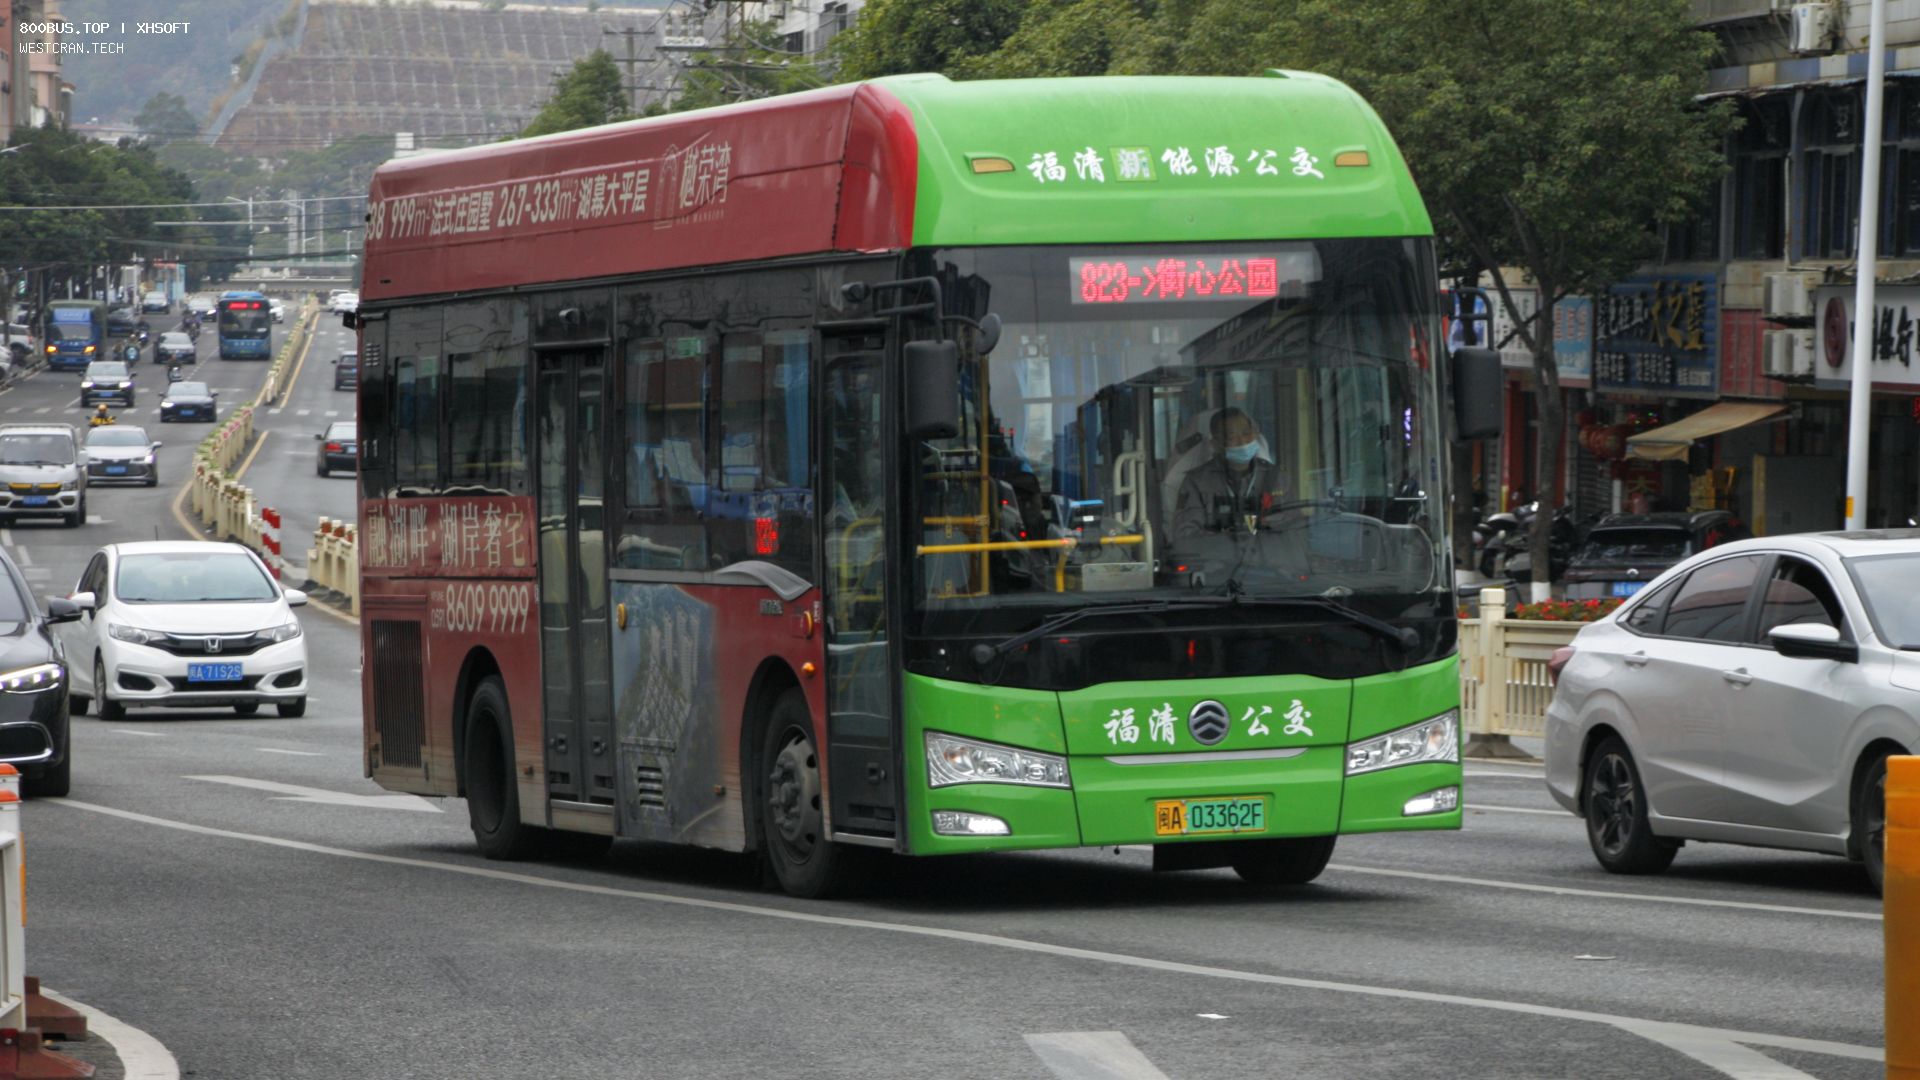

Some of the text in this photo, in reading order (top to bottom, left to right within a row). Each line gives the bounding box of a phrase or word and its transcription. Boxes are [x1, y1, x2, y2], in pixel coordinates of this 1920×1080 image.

[446, 583, 485, 632] 8609
[489, 584, 529, 634] 9999
[1103, 699, 1314, 746] 福清 公交
